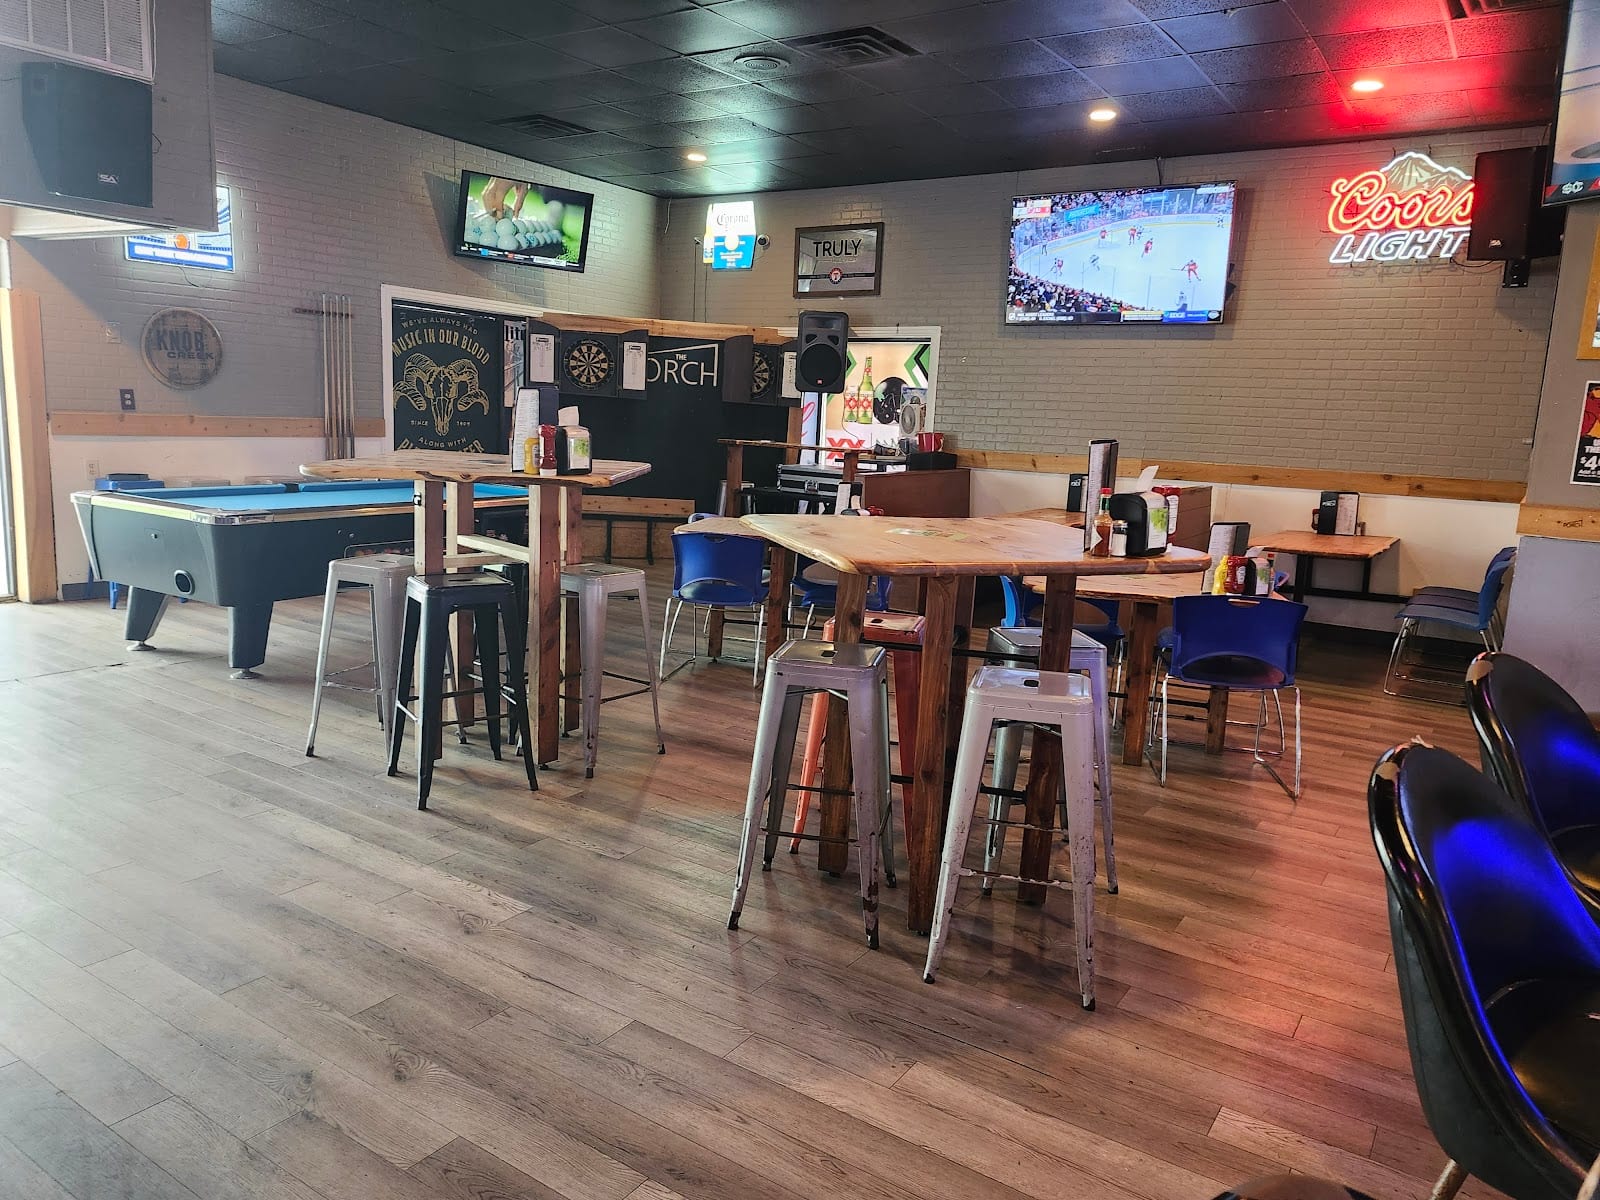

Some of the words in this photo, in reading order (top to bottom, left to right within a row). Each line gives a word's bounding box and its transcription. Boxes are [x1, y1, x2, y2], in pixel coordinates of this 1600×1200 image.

[1328, 171, 1475, 234] Coors
[717, 213, 749, 226] Corona
[813, 239, 862, 257] TRULY
[1329, 227, 1473, 263] LIGHT
[402, 317, 427, 329] WE'VE
[430, 316, 461, 327] ALWAYS
[463, 323, 478, 335] HAD
[167, 351, 214, 360] CREEK
[392, 329, 423, 358] MUSIC
[424, 328, 436, 343] IN
[439, 328, 460, 347] OUR
[461, 335, 491, 365] BLOOD
[675, 353, 687, 361] THE
[648, 346, 718, 387] ORCH
[418, 436, 445, 448] ALONG
[448, 437, 467, 448] WITH
